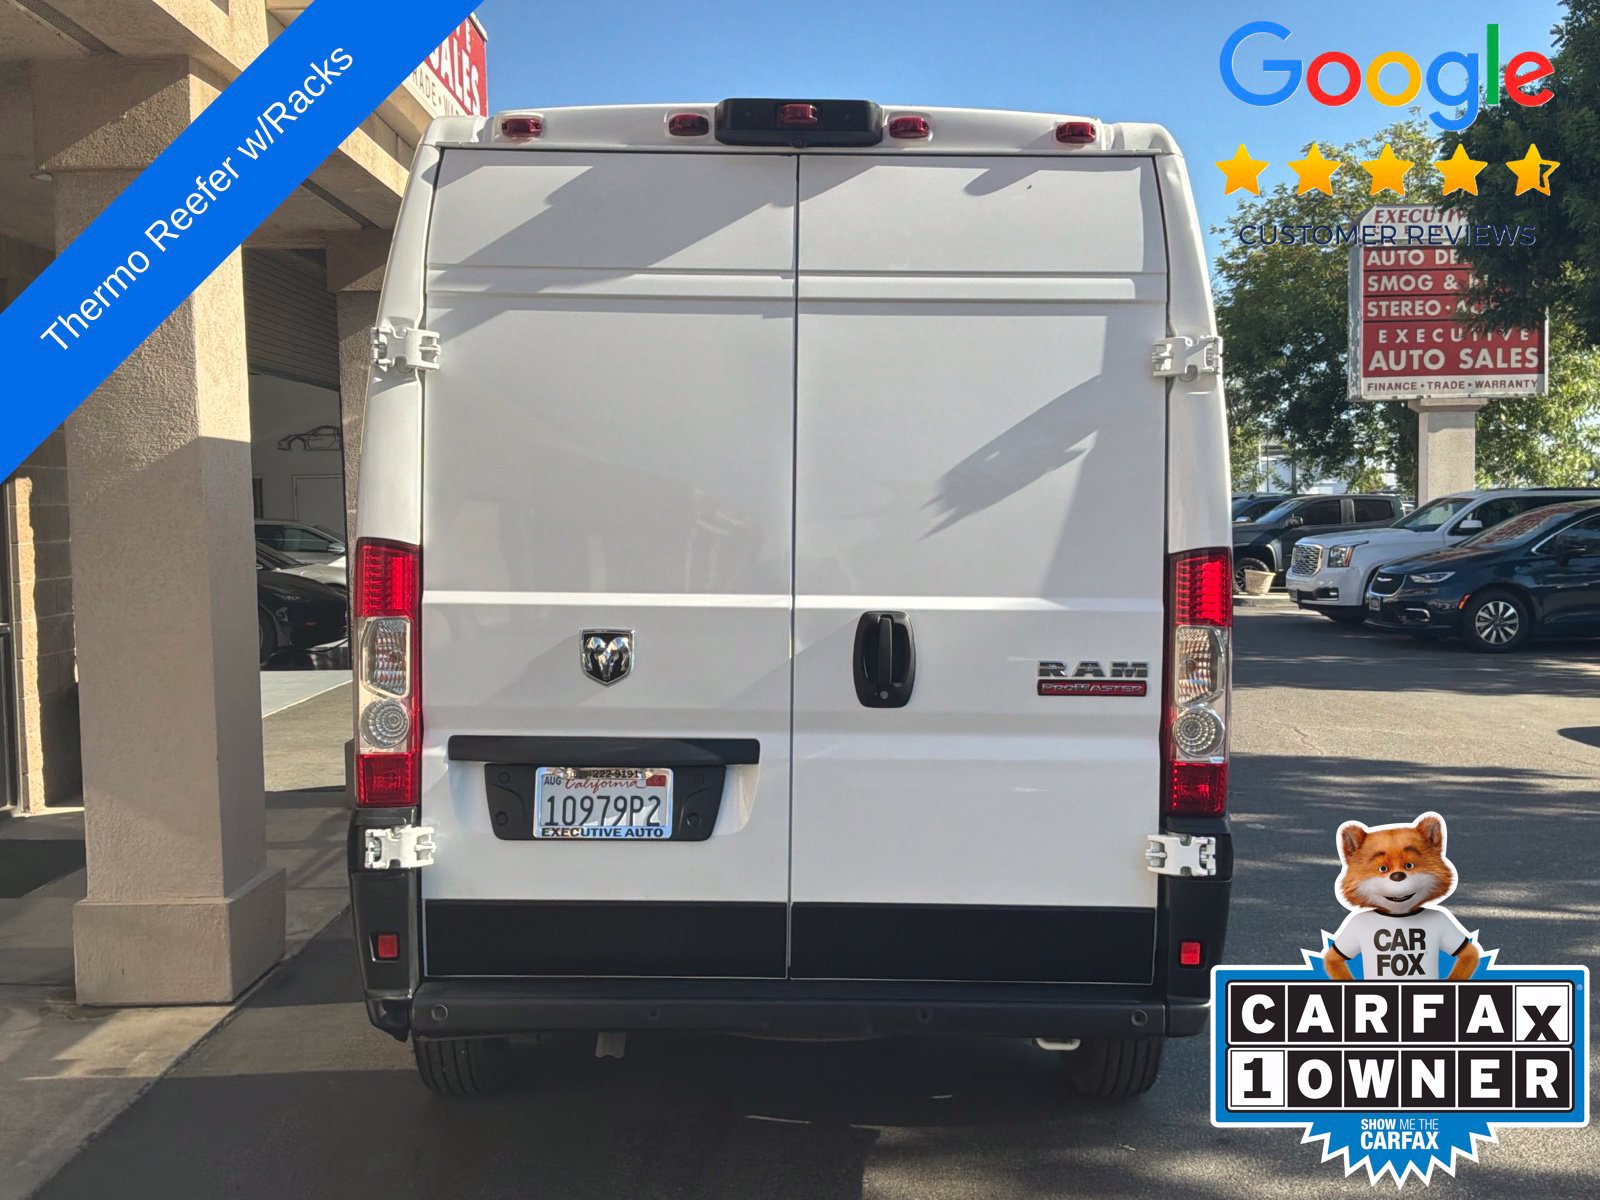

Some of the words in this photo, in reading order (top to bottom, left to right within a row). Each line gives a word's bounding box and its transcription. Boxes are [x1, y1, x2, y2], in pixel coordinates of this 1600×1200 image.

[1373, 208, 1468, 224] EXECUTIV
[1366, 248, 1425, 267] AUTO
[1367, 274, 1434, 292] SMOG
[1443, 274, 1459, 290] &
[1367, 299, 1442, 317] STEREO
[1368, 349, 1446, 371] AUTO
[1458, 347, 1539, 369] SALES
[1367, 381, 1418, 392] FINANCE
[1427, 380, 1465, 390] TRADE
[1475, 379, 1538, 389] WARRANTY
[1038, 660, 1148, 678] RAM
[544, 776, 562, 786] AUG
[565, 778, 647, 794] California
[544, 795, 661, 827] 10979P2
[541, 827, 622, 838] EXECUTIVE
[624, 828, 664, 838] AUTO
